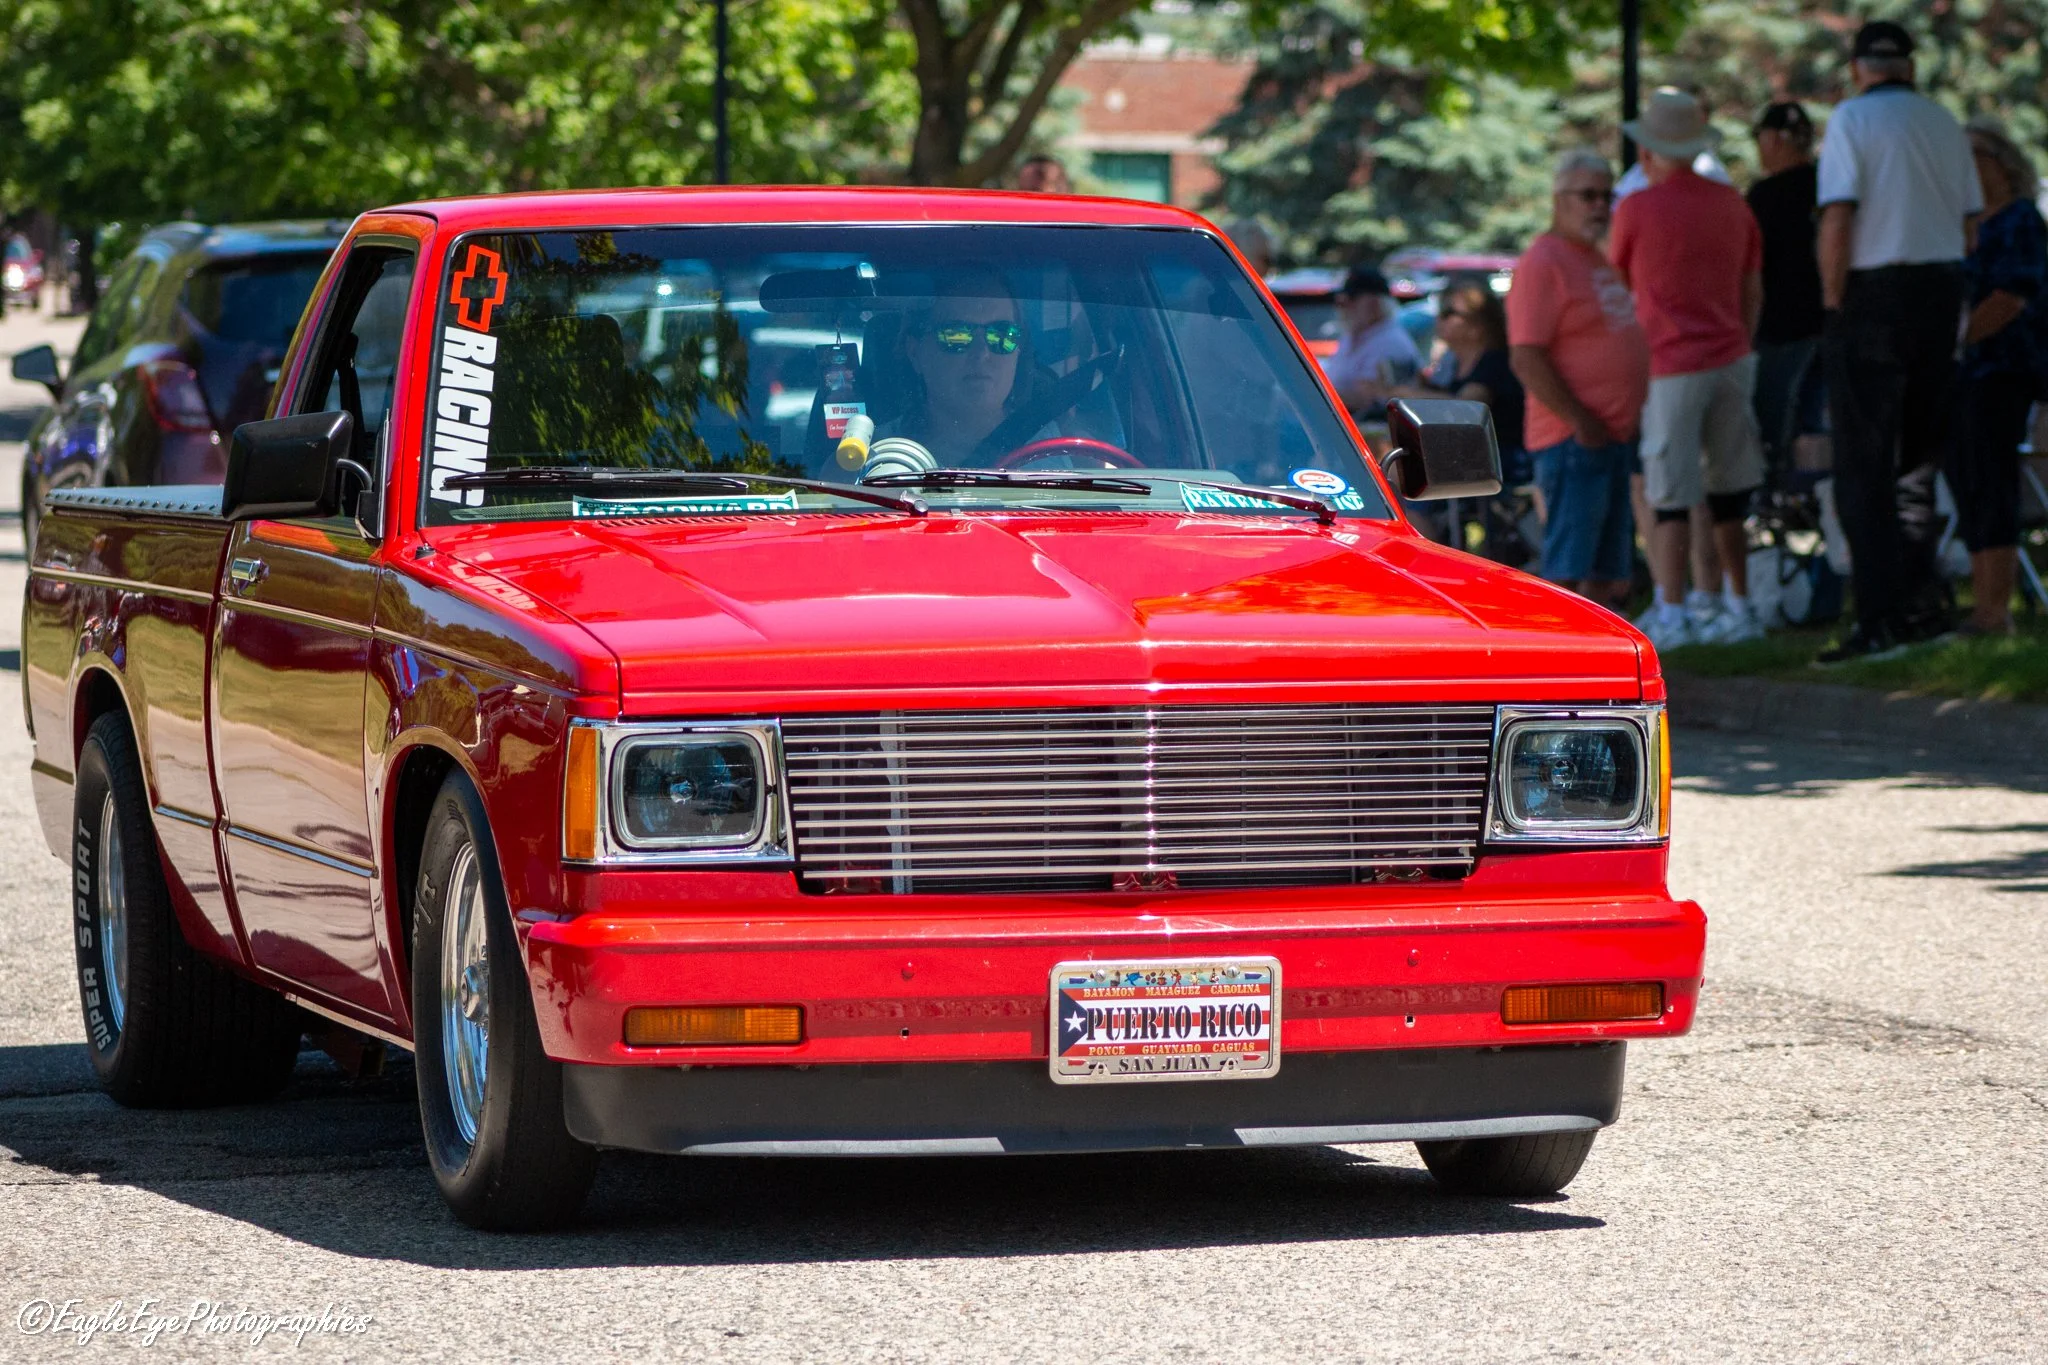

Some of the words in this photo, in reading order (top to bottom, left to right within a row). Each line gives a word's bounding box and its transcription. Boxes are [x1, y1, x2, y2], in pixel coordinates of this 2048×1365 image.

[429, 326, 498, 507] RACING
[832, 406, 841, 415] VIP
[841, 406, 859, 414] Access
[76, 818, 93, 949] SPORT
[1083, 987, 1136, 998] BAYAMON
[1145, 985, 1201, 997] MAYAGUEZ
[1210, 983, 1261, 995] CAROLINA
[83, 967, 112, 1051] SUPER
[1086, 1004, 1193, 1041] PUERTO
[1199, 1002, 1263, 1039] RICO
[1088, 1045, 1126, 1056] PONCE
[1141, 1043, 1202, 1055] GUAYNABO
[1212, 1042, 1255, 1053] CAGUAS
[1118, 1056, 1156, 1073] SAN
[1161, 1054, 1212, 1072] JUAN
